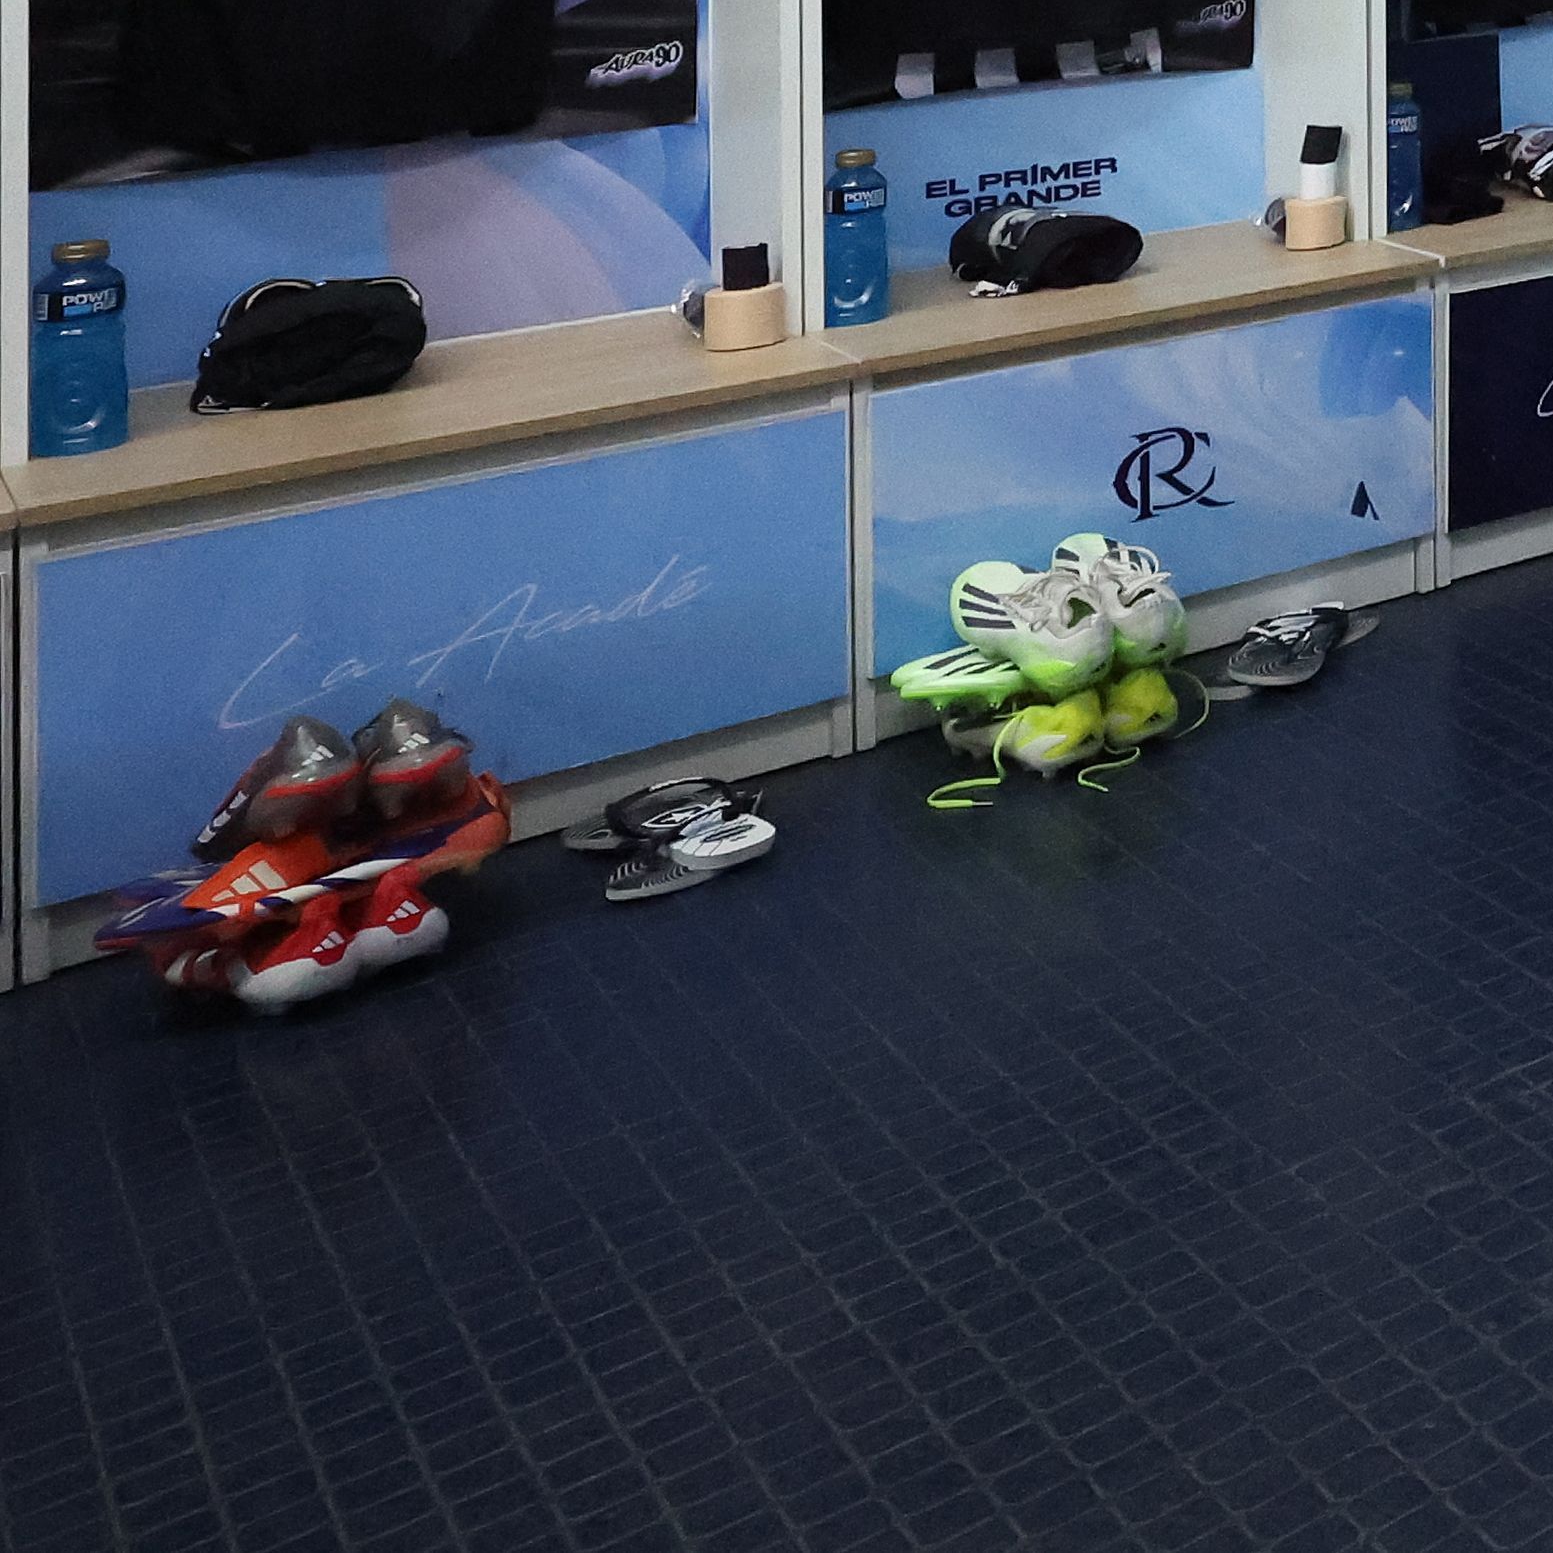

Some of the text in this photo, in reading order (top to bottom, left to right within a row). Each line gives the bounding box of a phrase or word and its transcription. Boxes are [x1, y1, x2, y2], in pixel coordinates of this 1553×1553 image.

[925, 157, 1118, 198] EL PRIMER
[944, 180, 1102, 218] GRANDE
